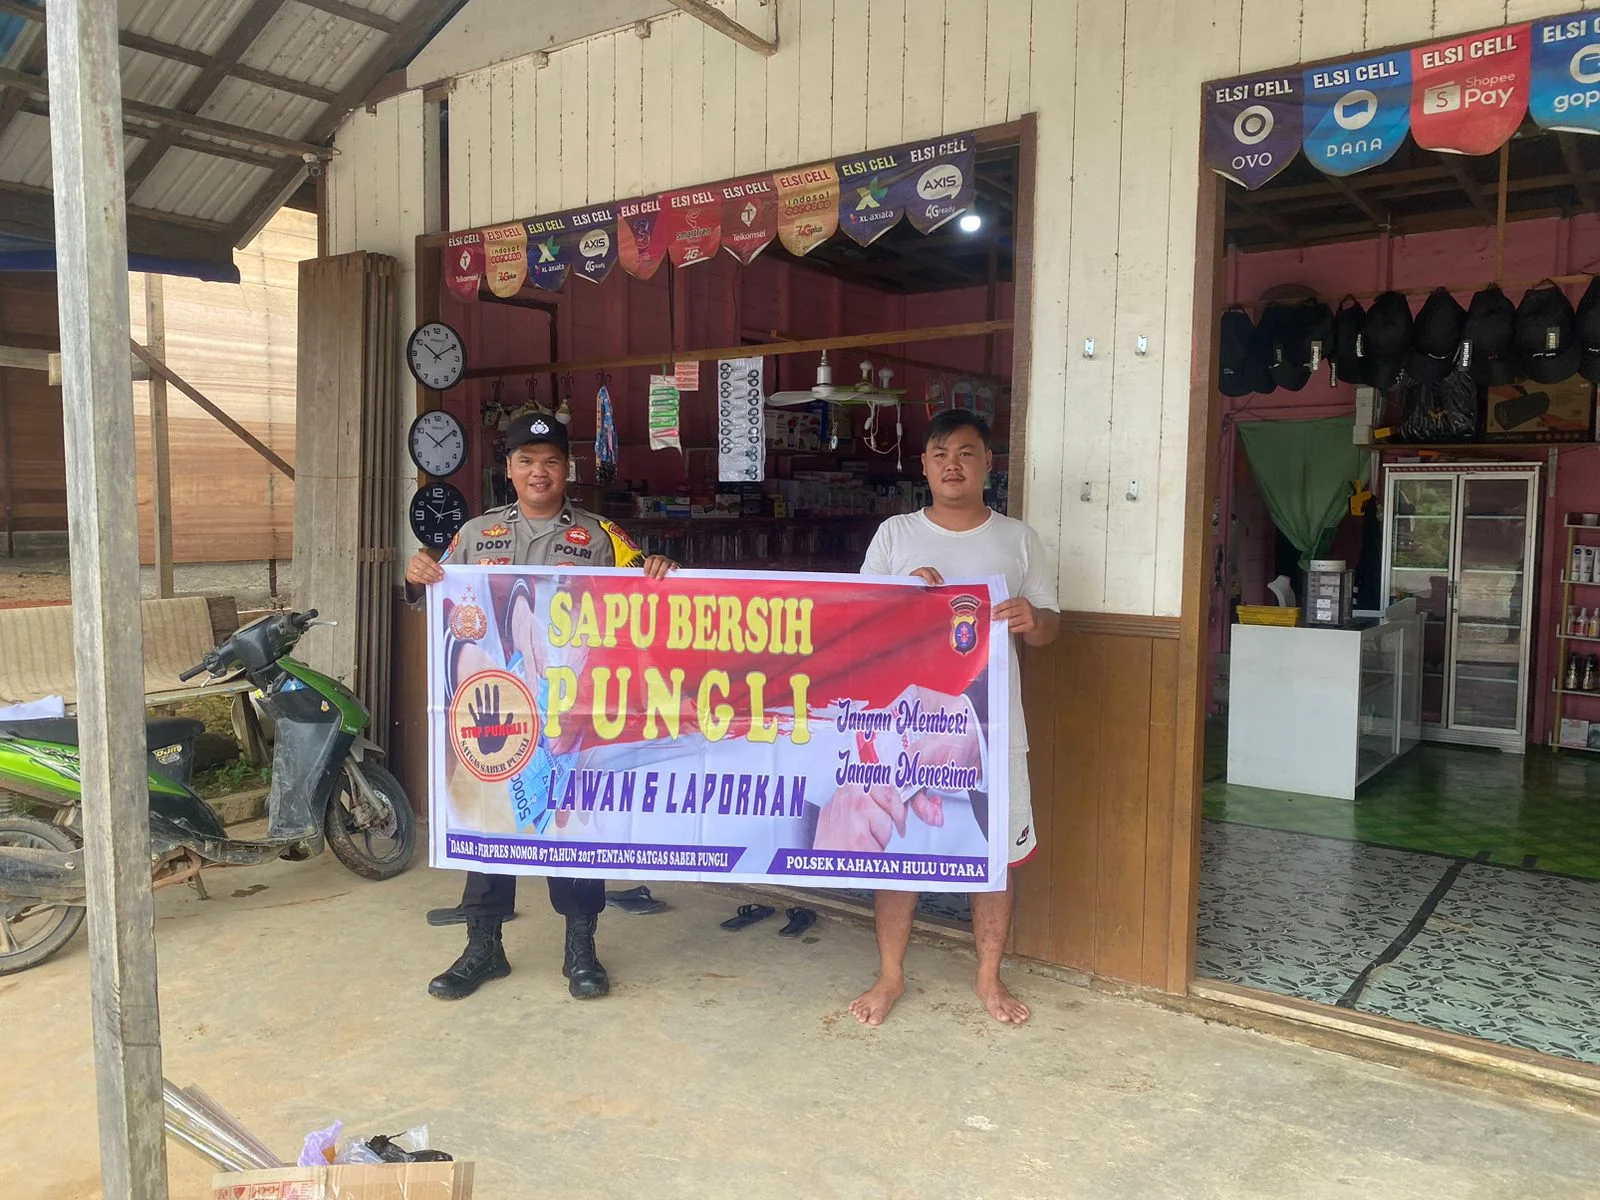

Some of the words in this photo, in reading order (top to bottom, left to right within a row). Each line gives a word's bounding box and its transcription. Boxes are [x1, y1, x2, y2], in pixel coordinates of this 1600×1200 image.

[1543, 19, 1586, 43] ELSI
[1422, 45, 1464, 69] ELSI
[1469, 34, 1517, 60] CELL
[1313, 69, 1350, 89] ELSI
[1355, 60, 1399, 81] CELL
[1466, 73, 1515, 88] Shopee
[1216, 85, 1249, 104] ELSI
[1254, 79, 1293, 97] CELL
[1464, 87, 1514, 108] Pay
[1554, 90, 1600, 112] gop
[910, 147, 935, 163] ELSI
[939, 140, 967, 155] CELL
[1327, 138, 1382, 158] DANA
[842, 162, 867, 176] ELSI
[870, 155, 897, 171] CELL
[1232, 153, 1272, 170] OVO
[780, 175, 803, 188] ELSI
[805, 170, 831, 183] CELL
[923, 175, 956, 191] AXIS
[723, 185, 743, 198] ELSI
[745, 181, 770, 194] CELL
[671, 195, 690, 208] ELSI
[692, 192, 714, 204] CELL
[787, 191, 830, 205] indosat
[621, 205, 639, 217] ELSI
[641, 201, 660, 212] CELL
[786, 200, 832, 216] ooredoo
[870, 211, 894, 221] axiata
[573, 215, 591, 226] ELSI
[593, 210, 612, 221] CELL
[488, 230, 503, 240] ELSI
[504, 228, 521, 237] CELL
[528, 223, 546, 234] ELSI
[546, 219, 565, 230] CELL
[449, 236, 462, 247] ELSI
[464, 234, 480, 244] CELL
[733, 229, 766, 242] Telkomsel
[492, 246, 520, 254] indosat
[583, 238, 605, 250] AXIS
[491, 252, 522, 264] ooredoo
[684, 249, 698, 260] 4G
[456, 274, 478, 282] Telkomsel
[433, 488, 443, 498] 12
[415, 510, 424, 520] 9
[452, 511, 461, 520] 3
[434, 533, 443, 543] 6
[476, 540, 512, 551] DODY
[554, 544, 591, 559] POLRI
[548, 591, 659, 648] SAPU
[666, 594, 814, 655] BERSIH
[544, 665, 811, 745] PUNGLI
[836, 699, 892, 739] Jangan
[461, 726, 481, 738] STOP
[485, 722, 521, 738] PUNGLI
[460, 740, 480, 769] SATGAS
[480, 763, 507, 773] SABER
[507, 738, 530, 767] PUNGLI
[836, 750, 891, 793] Jangan
[546, 770, 636, 812] LAWAN
[642, 772, 658, 812] &
[666, 772, 807, 817] LAPORKAN
[510, 846, 538, 860] NOMOR
[539, 848, 547, 862] 87
[549, 848, 576, 862] TAHUN
[578, 850, 595, 864] 2017
[596, 849, 635, 864] TENTANG
[636, 851, 668, 864] SATGAS
[669, 852, 696, 866] SABER
[697, 852, 728, 866] PUNGLI
[786, 856, 834, 870] POLSEK
[837, 858, 900, 873] KAHAYAN
[902, 860, 937, 876] HULU
